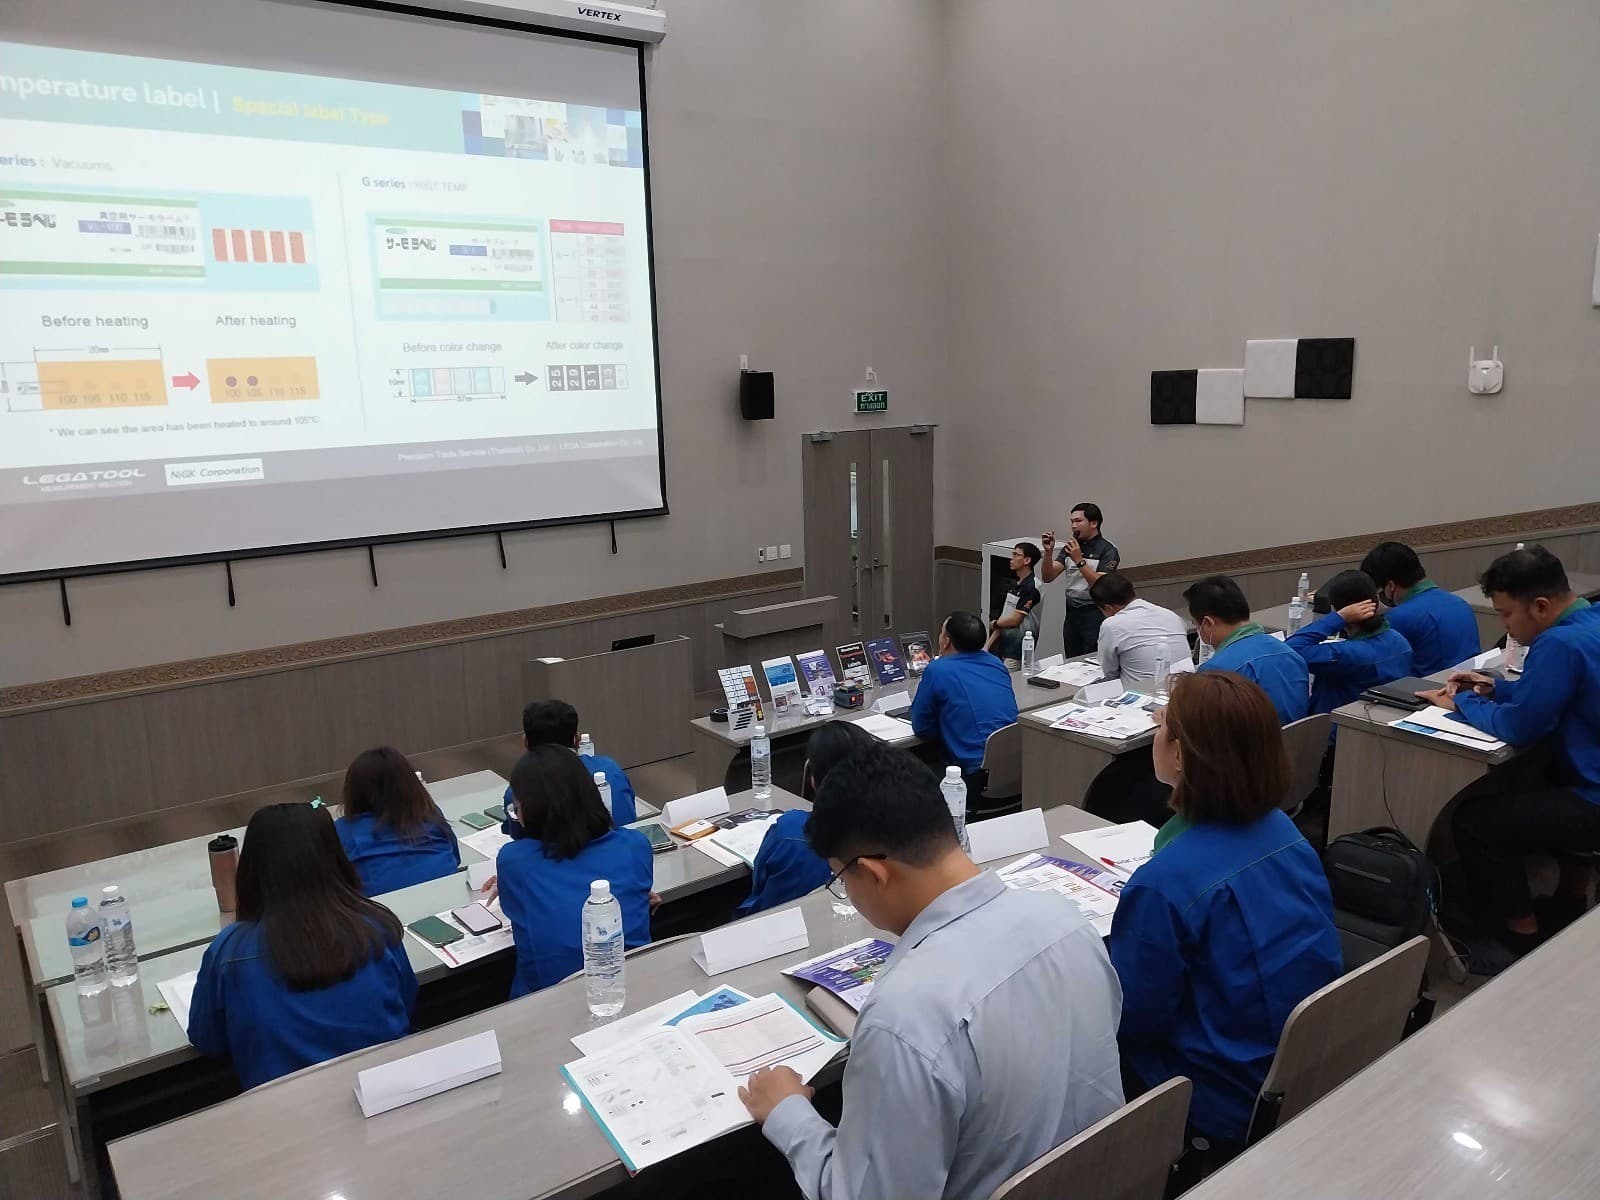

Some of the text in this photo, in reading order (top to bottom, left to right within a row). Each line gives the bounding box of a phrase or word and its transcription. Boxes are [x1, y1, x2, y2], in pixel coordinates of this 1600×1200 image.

[577, 7, 621, 21] VERTEX
[144, 80, 207, 110] label
[361, 176, 371, 187] G
[373, 178, 406, 190] series
[41, 315, 149, 330] Before heating
[215, 315, 297, 329] After heating
[402, 342, 503, 354] Before color change
[545, 340, 567, 350] After
[569, 369, 579, 387] 29
[861, 393, 884, 402] EXIT
[57, 427, 74, 437] We
[78, 427, 97, 436] can
[101, 426, 119, 435] see
[122, 424, 138, 434] the
[142, 424, 164, 433] area
[166, 422, 184, 431] has
[187, 420, 212, 430] been
[248, 418, 257, 427] to
[22, 468, 146, 486] LEGATOOL
[199, 466, 260, 478] Corporation
